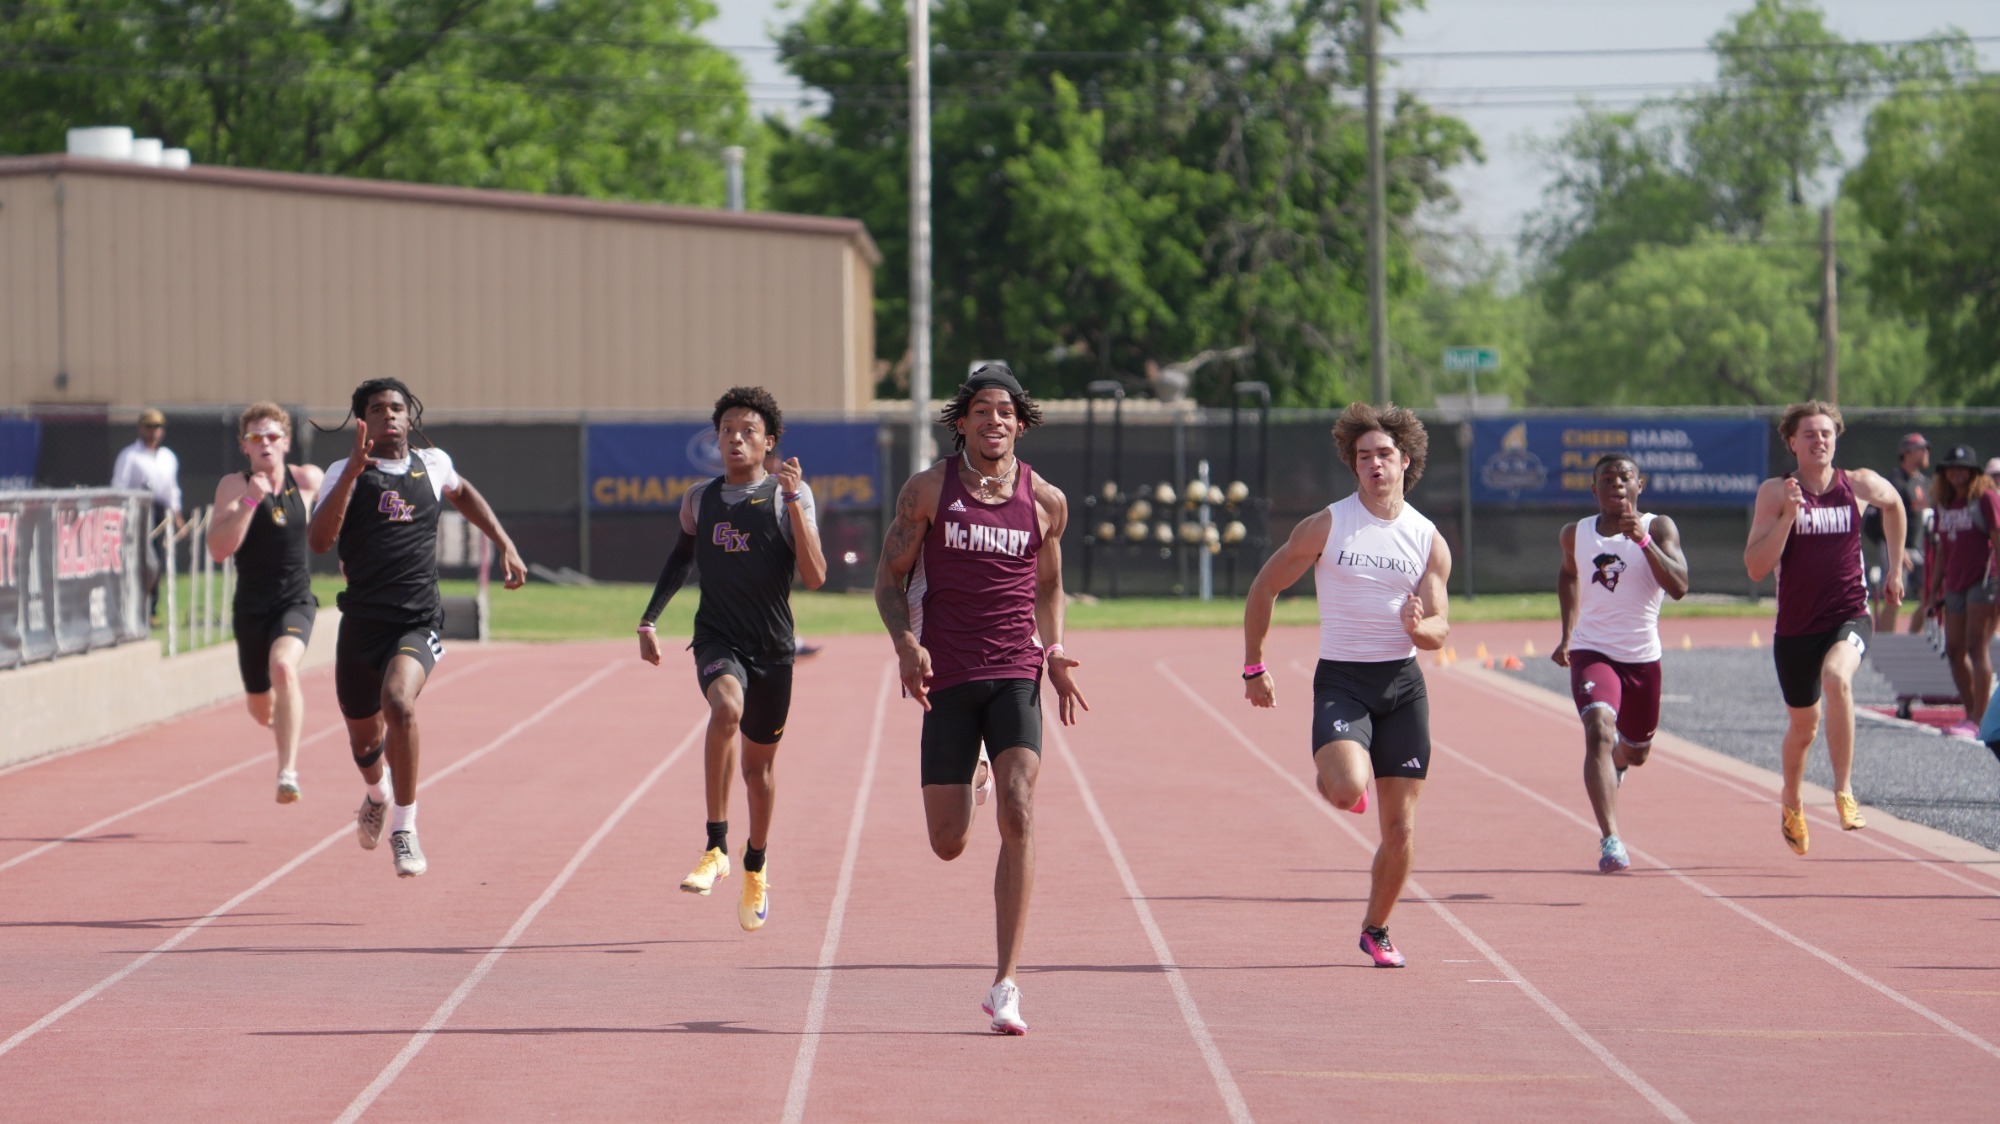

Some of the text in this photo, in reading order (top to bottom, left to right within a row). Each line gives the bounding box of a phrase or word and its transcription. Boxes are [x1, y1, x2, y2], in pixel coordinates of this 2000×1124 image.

[1562, 429, 1628, 447] CHEER
[1633, 451, 1703, 470] ARDER.
[1336, 550, 1421, 576] HENDRIX
